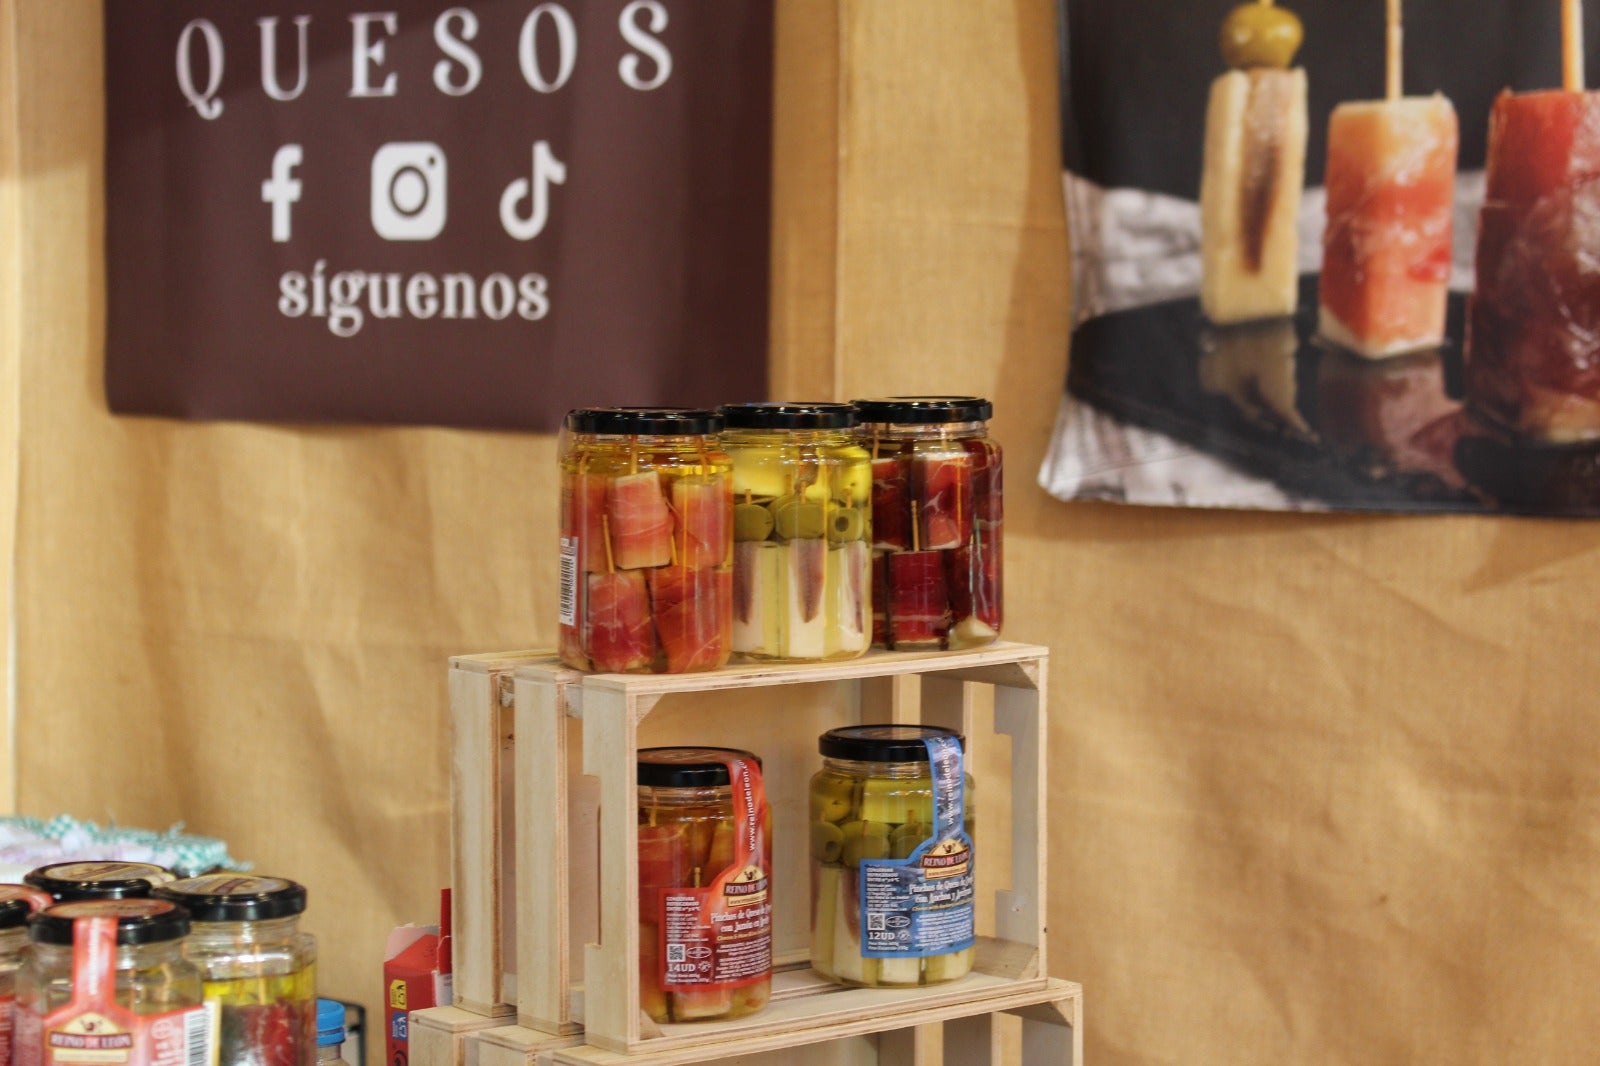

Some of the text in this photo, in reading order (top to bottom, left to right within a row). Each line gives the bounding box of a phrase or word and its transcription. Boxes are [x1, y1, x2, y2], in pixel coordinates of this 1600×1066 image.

[175, 0, 673, 119] QUESOS
[279, 260, 550, 337] síguenos
[868, 932, 896, 940] 12UD
[668, 963, 696, 972] 14UD
